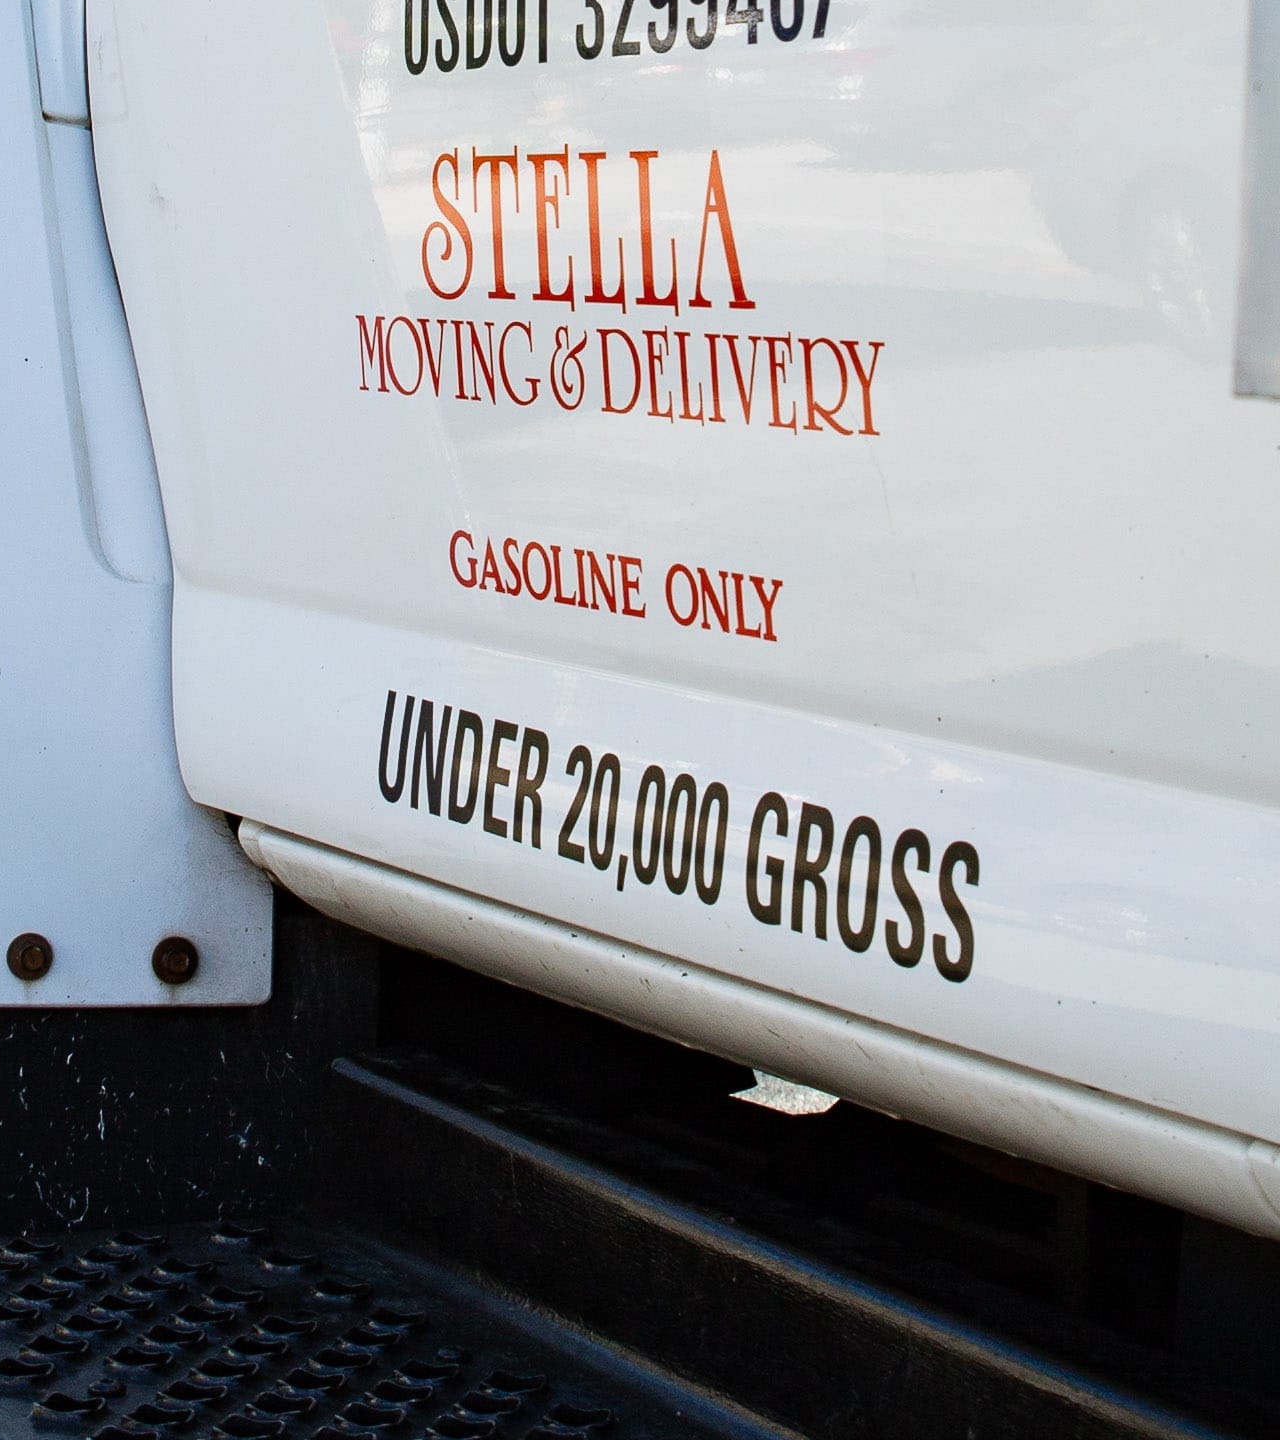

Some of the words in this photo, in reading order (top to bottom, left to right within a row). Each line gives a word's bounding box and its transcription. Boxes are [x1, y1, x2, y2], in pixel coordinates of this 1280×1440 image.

[421, 143, 756, 317] STELLA
[356, 315, 540, 407] MOVING
[550, 325, 588, 411] &
[598, 326, 885, 437] DELIVERY
[449, 530, 647, 618] GASOLINE
[664, 563, 784, 643] ONLY
[378, 690, 550, 850] UNDER
[557, 744, 729, 905] 20,000
[745, 791, 980, 984] GROSS
